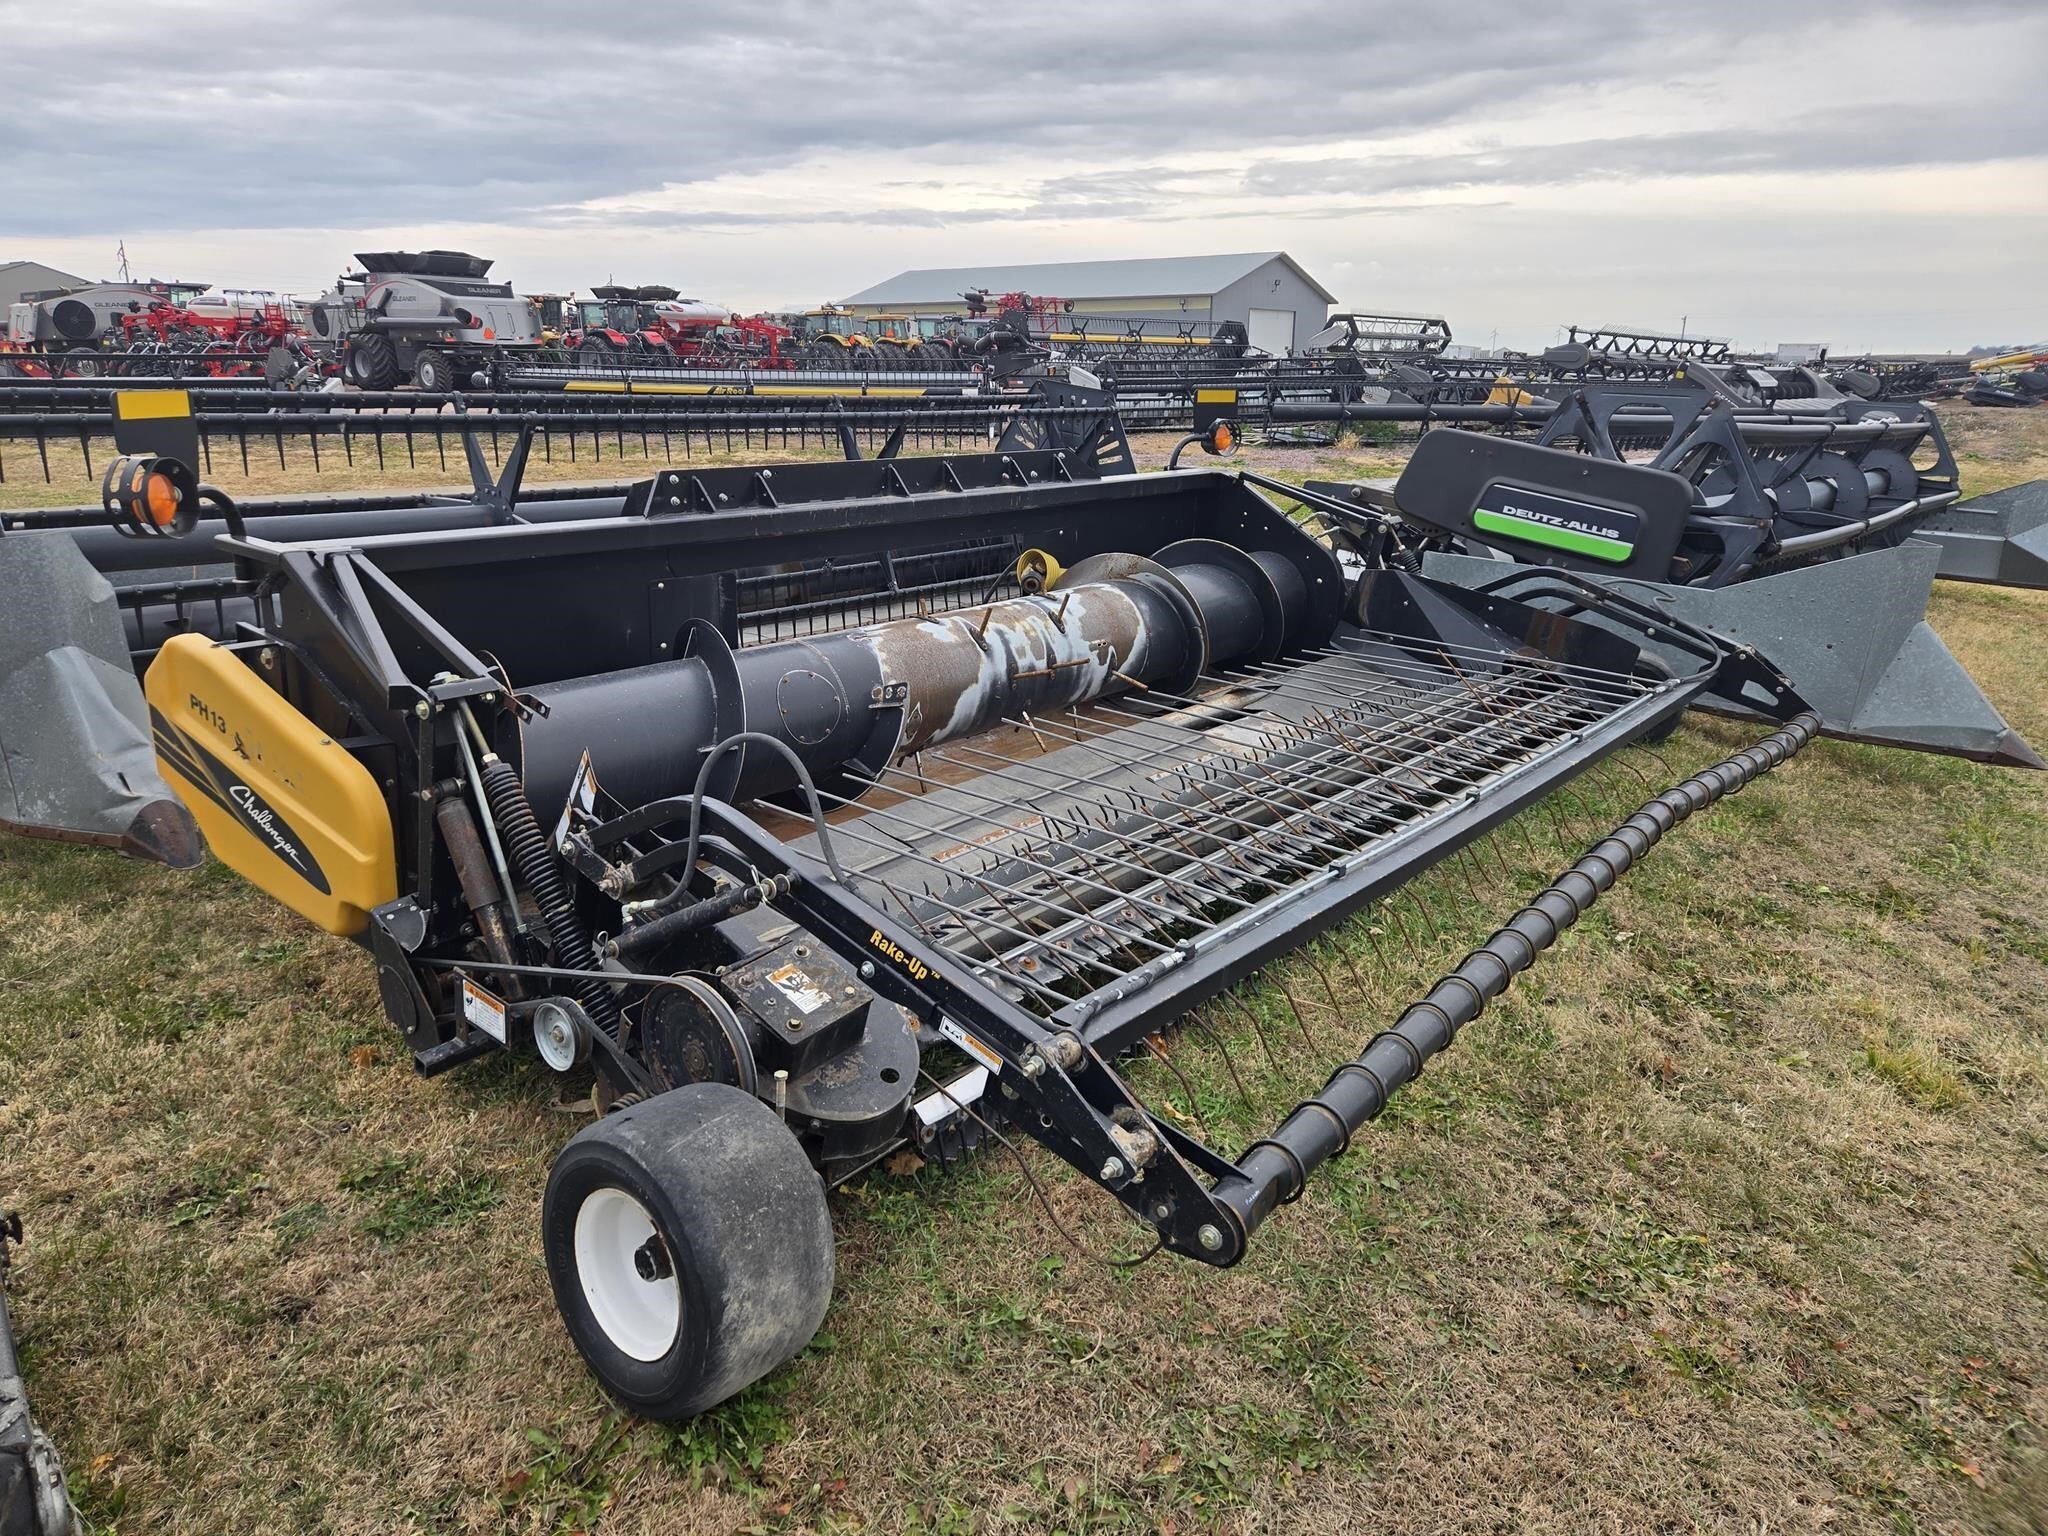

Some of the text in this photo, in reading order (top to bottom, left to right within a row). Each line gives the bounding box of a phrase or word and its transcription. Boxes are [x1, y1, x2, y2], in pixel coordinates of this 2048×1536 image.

[1502, 505, 1620, 539] DEUTZ-ALLIS
[229, 785, 308, 872] Challenger
[869, 930, 928, 980] Rake-Up
